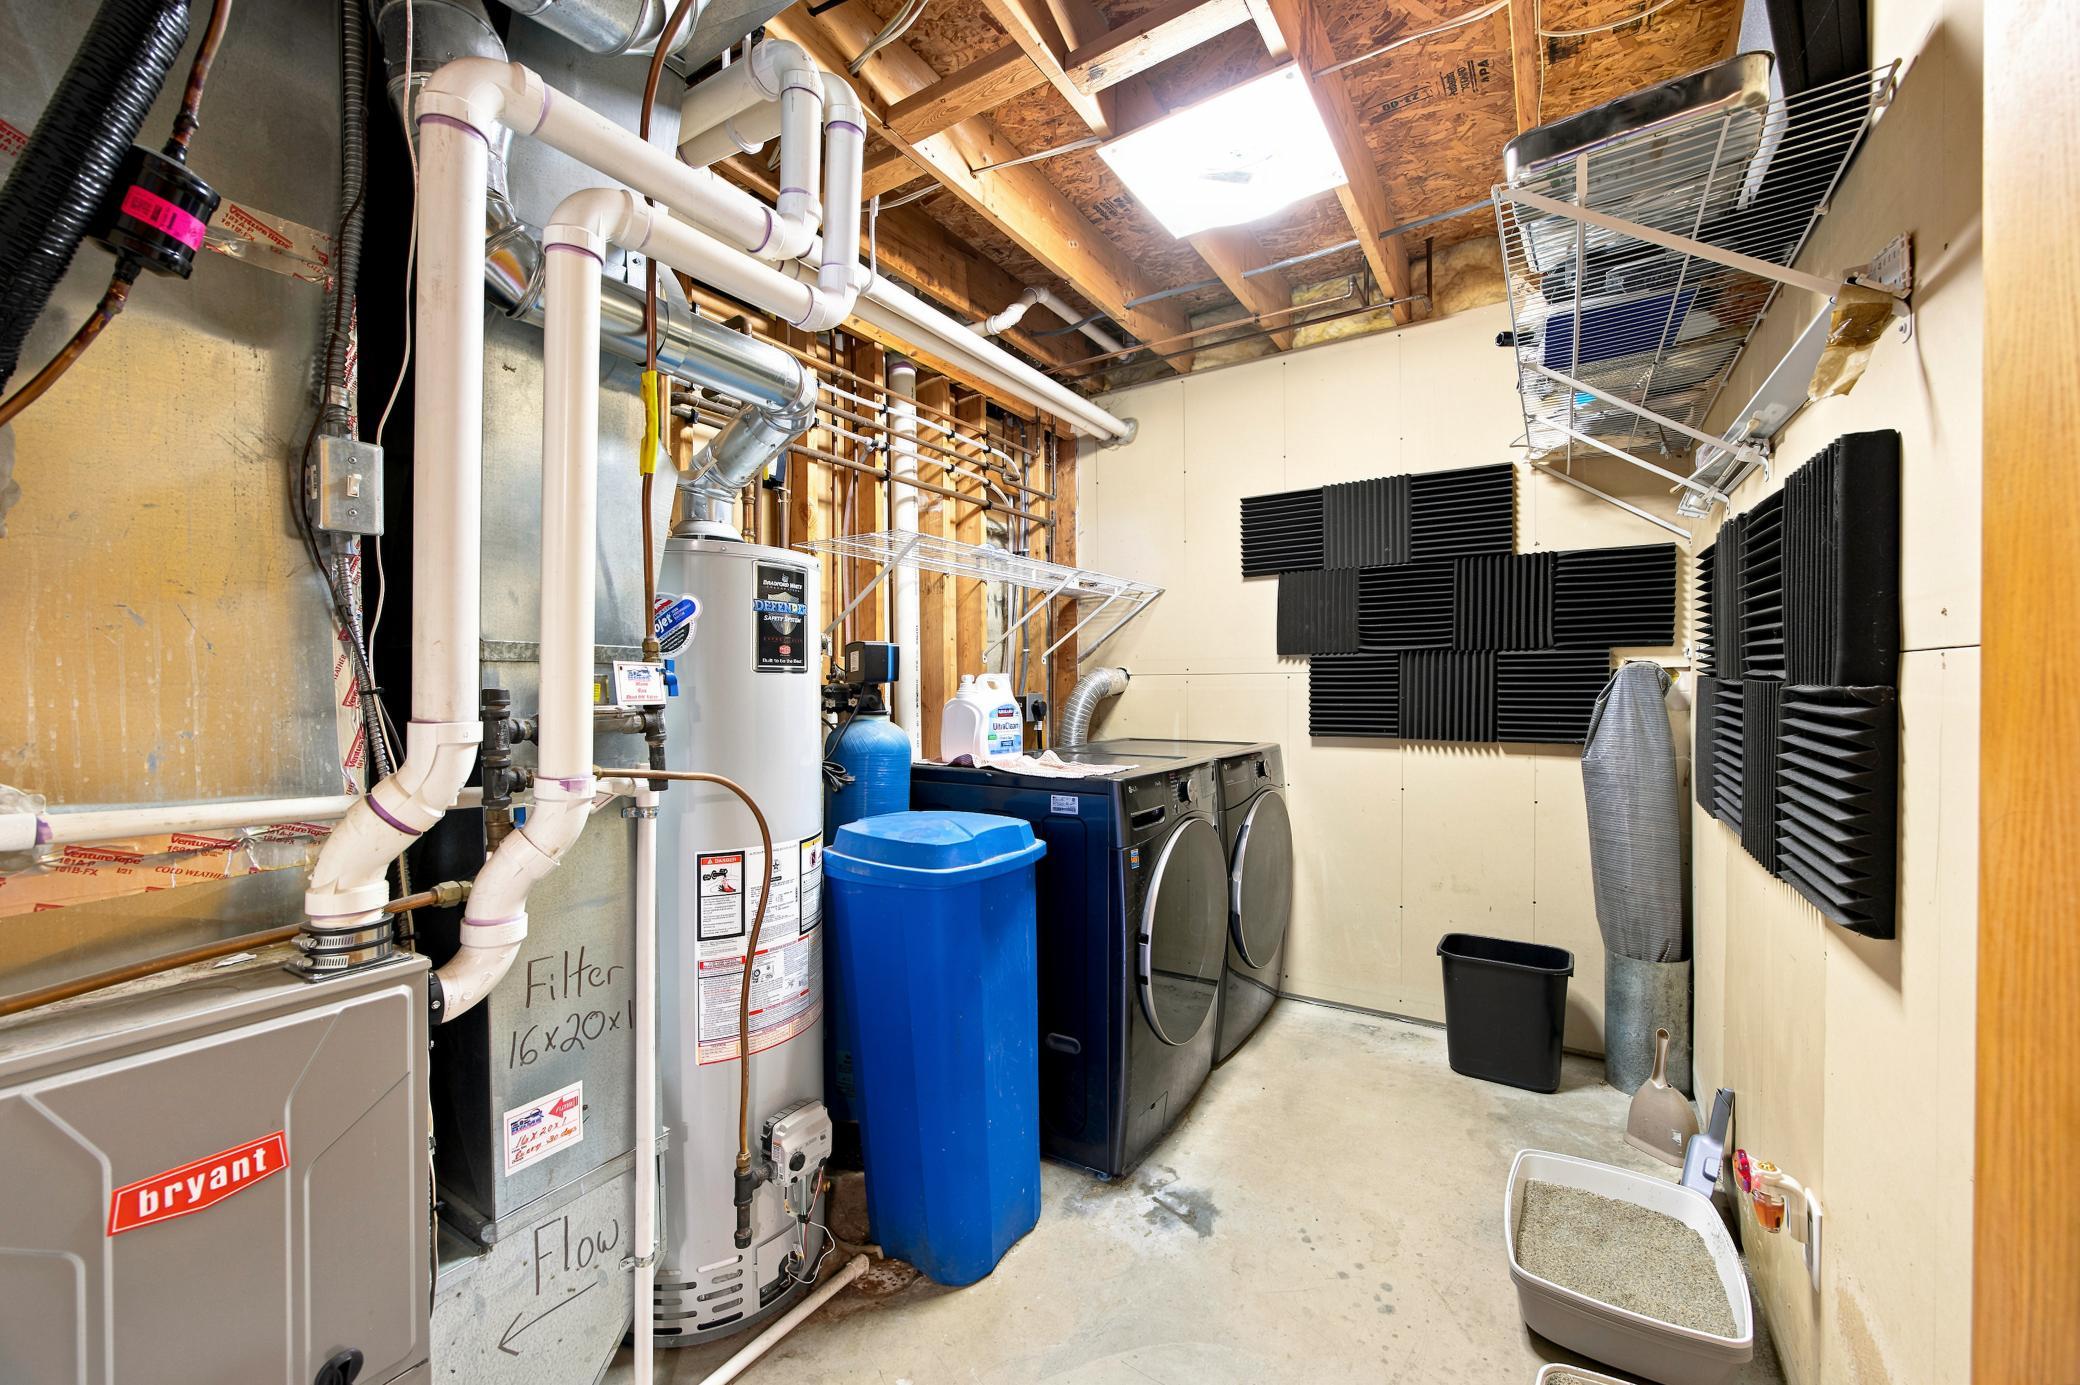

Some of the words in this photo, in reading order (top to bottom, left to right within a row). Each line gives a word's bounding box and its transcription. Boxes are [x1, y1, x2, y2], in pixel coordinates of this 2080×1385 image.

[754, 599, 807, 616] DEFENDER
[64, 848, 143, 865] VentureTape
[526, 946, 625, 1008] Filter
[138, 1147, 267, 1218] bryant
[534, 1215, 619, 1296] Flow
